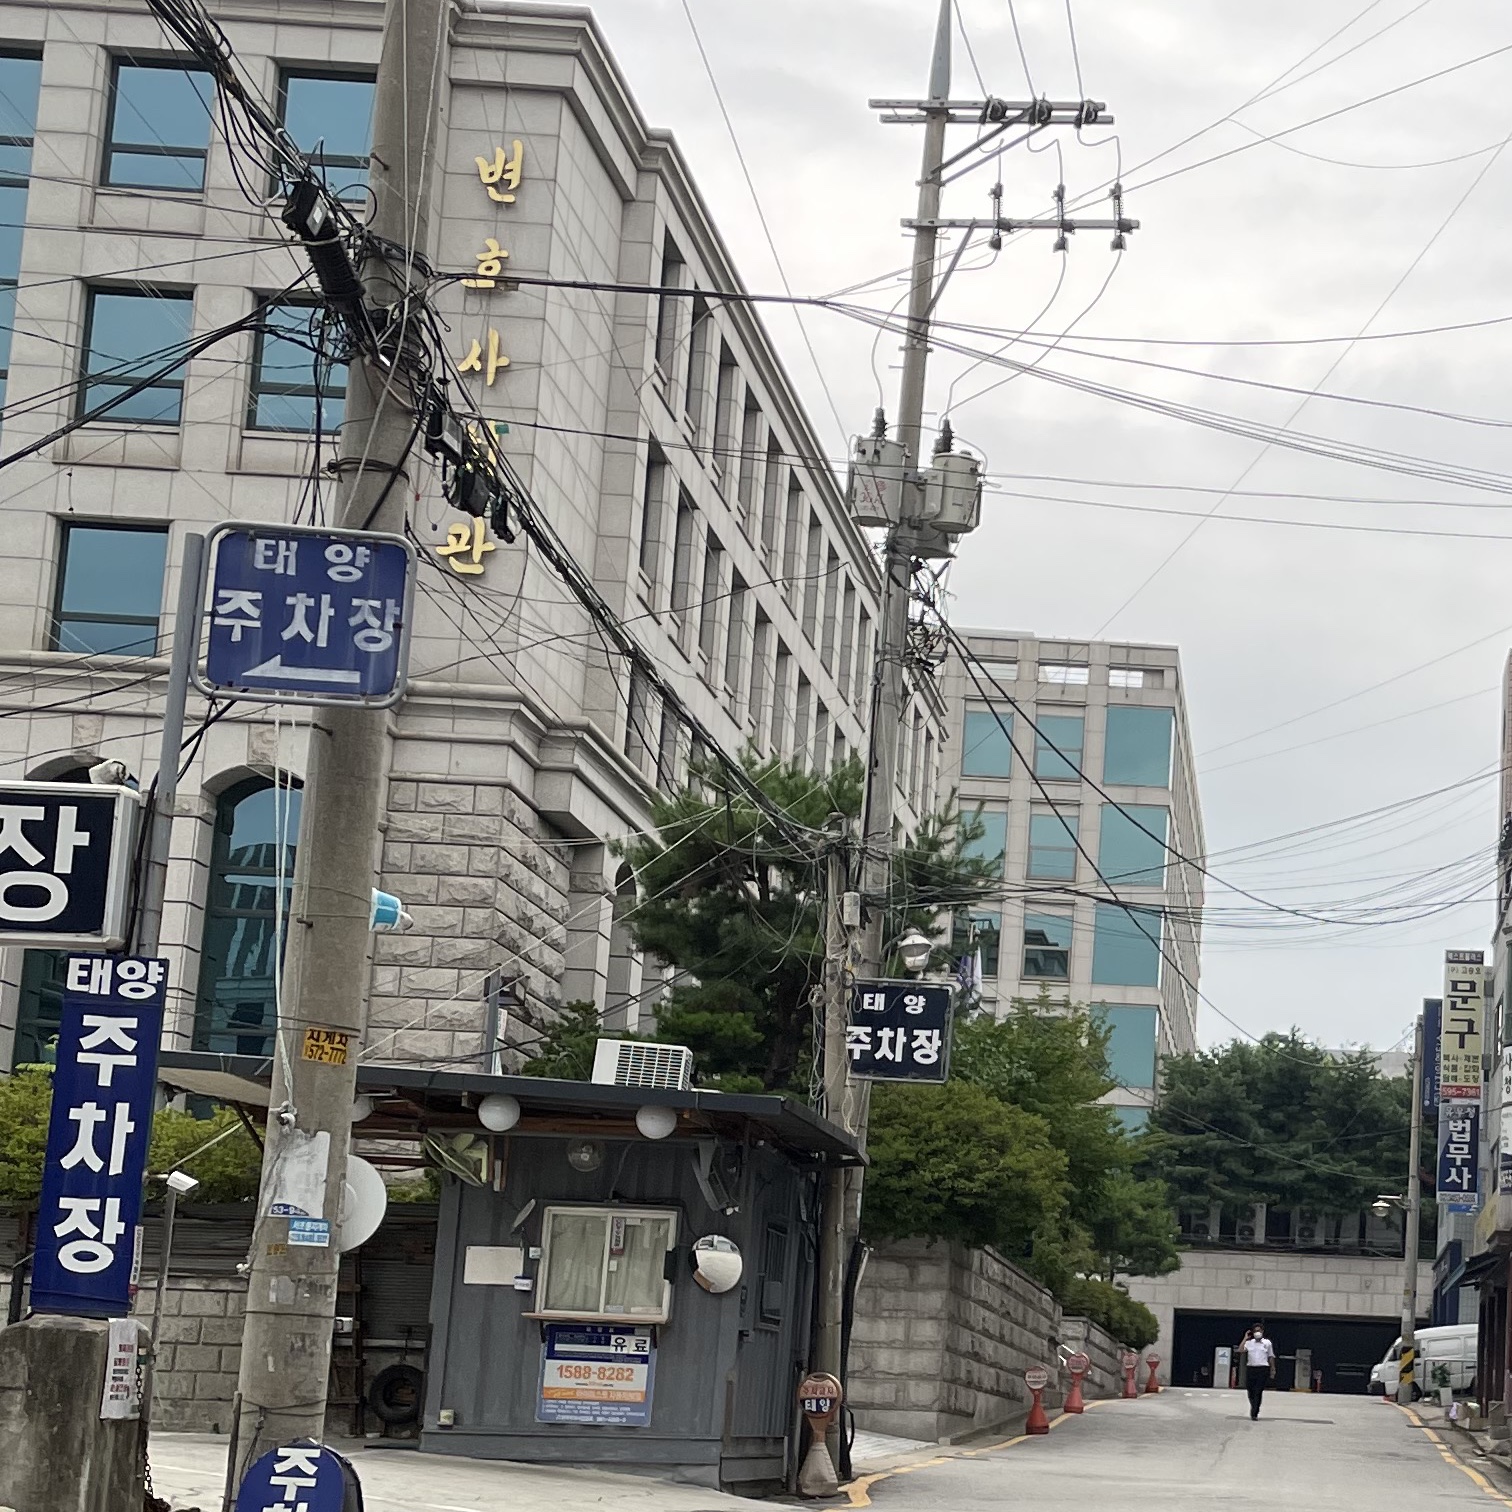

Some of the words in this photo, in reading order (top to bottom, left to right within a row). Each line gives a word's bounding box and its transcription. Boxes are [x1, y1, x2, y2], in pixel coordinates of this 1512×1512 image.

[0, 805, 90, 922] 장
[66, 958, 164, 999] 태양
[846, 1026, 942, 1064] 주차장
[1445, 979, 1481, 1049] 문구
[53, 1015, 139, 1274] 주차장
[1445, 1119, 1472, 1190] 법무사
[557, 1365, 634, 1381] 1588-8282
